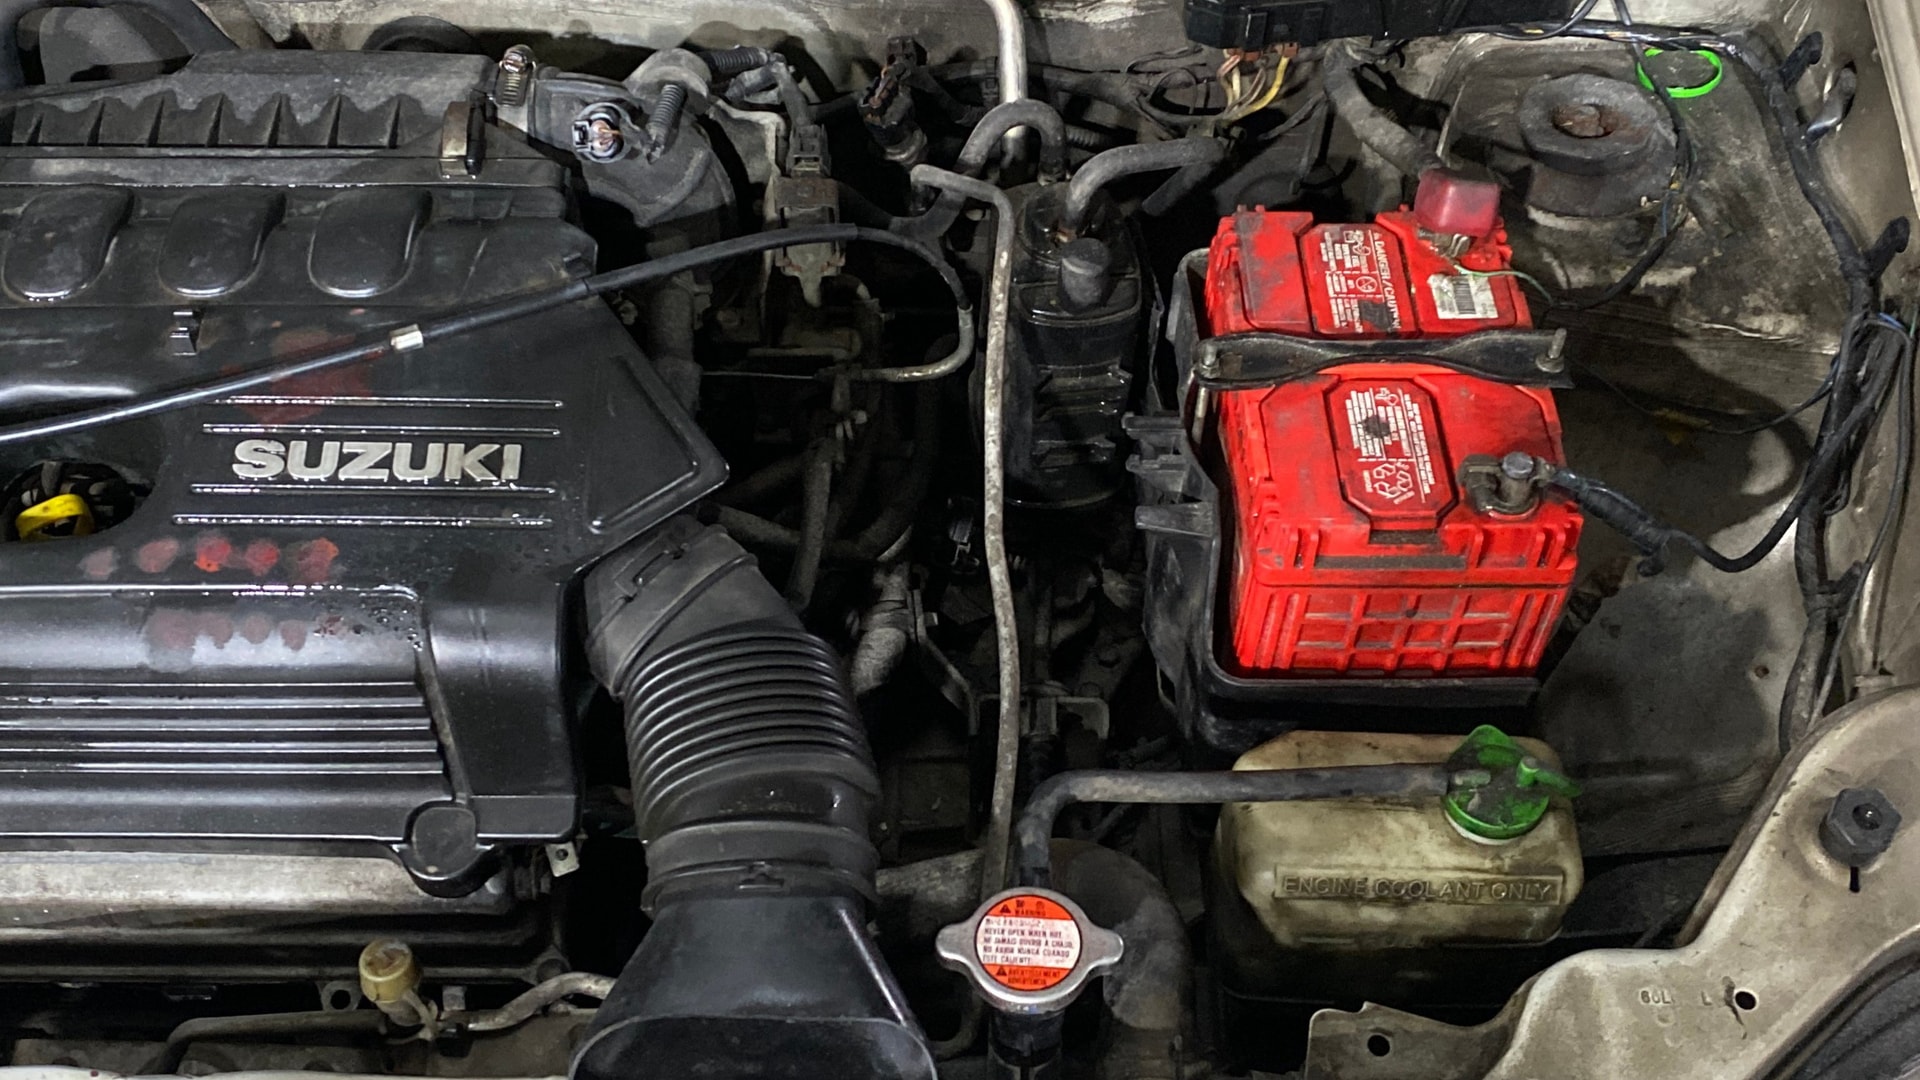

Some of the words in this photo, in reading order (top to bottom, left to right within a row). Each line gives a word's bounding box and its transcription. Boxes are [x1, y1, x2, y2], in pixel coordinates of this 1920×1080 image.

[1374, 240, 1402, 329] DANGER/CAUTN
[232, 439, 522, 481] SUZUKI
[1283, 876, 1368, 895] ENGINE
[1375, 878, 1484, 899] COOLANT
[1491, 882, 1550, 900] ONLY
[984, 928, 1005, 936] NEVER
[1008, 929, 1025, 937] OPEN
[1028, 930, 1047, 938] WHEN
[1017, 947, 1040, 956] NUNCA
[1042, 949, 1070, 958] CUANDO
